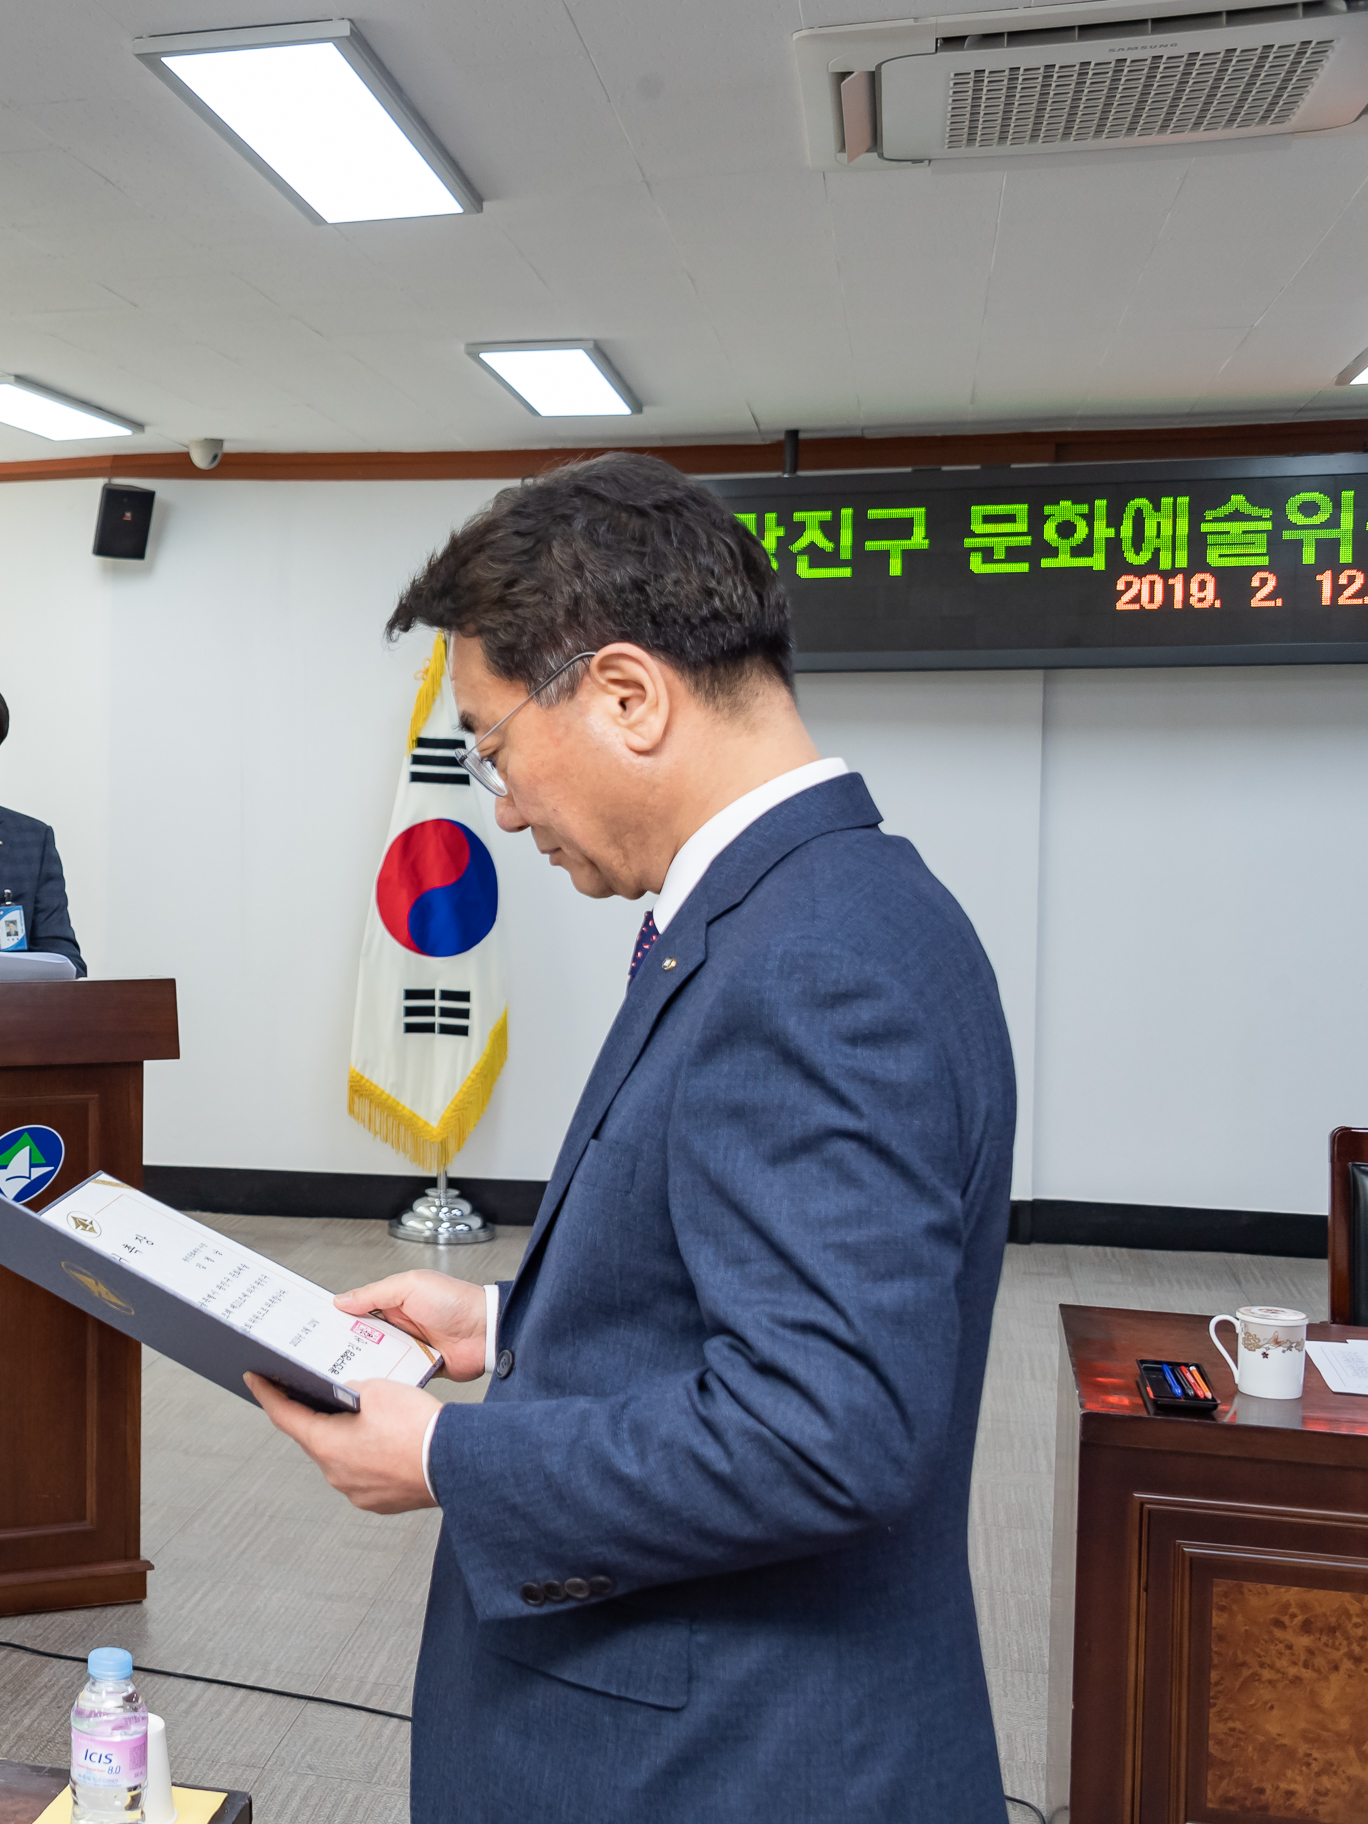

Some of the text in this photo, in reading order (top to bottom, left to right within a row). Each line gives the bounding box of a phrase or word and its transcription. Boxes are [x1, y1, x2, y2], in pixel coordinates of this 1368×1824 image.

[1108, 42, 1178, 53] SAMSUNG
[963, 490, 1368, 573] 문화예술위
[1116, 573, 1221, 610] 2019.
[1250, 571, 1283, 607] 2.
[107, 1765, 121, 1775] 8.0
